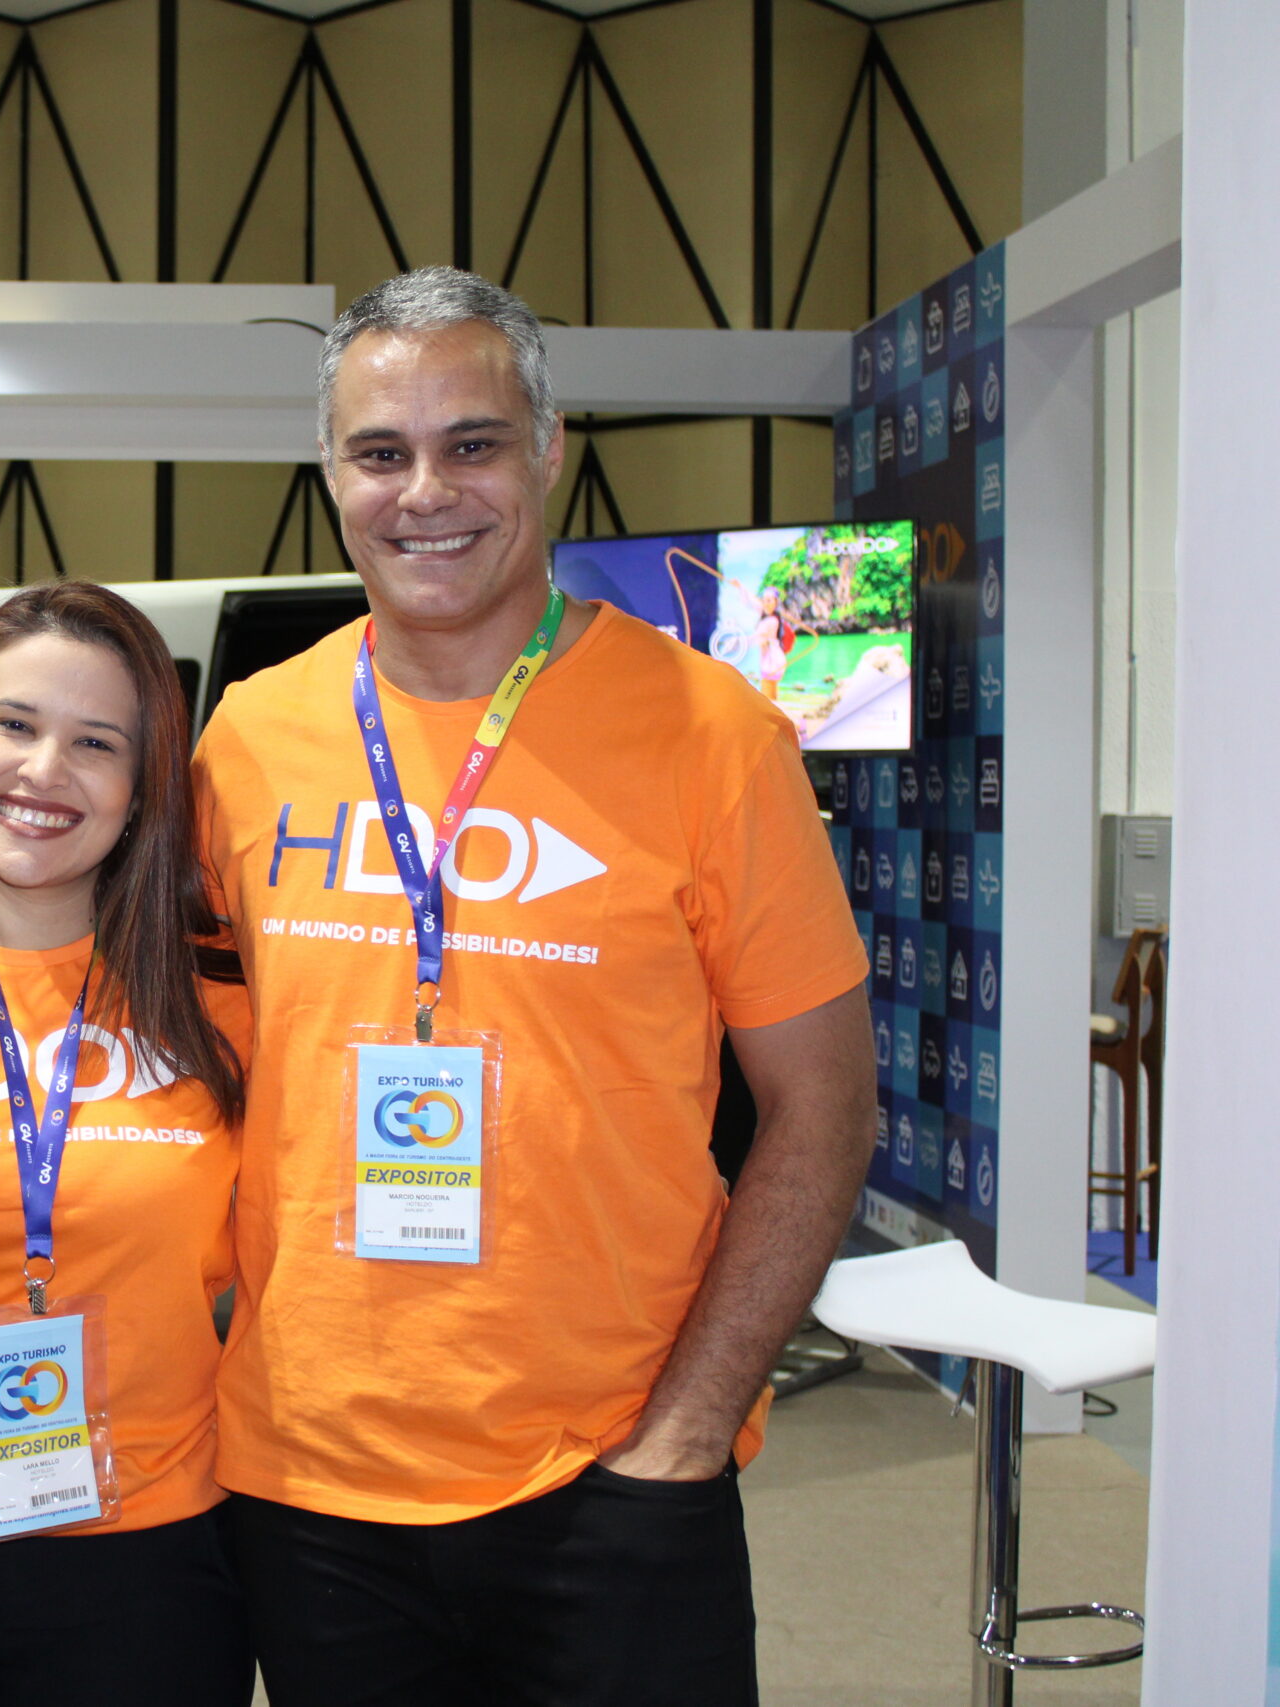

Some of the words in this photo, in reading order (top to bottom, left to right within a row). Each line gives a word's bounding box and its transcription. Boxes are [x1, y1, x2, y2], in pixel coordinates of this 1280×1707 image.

[267, 801, 531, 902] HDO
[262, 917, 286, 935] UM
[289, 919, 366, 943] MUNDO
[371, 927, 401, 946] DE
[405, 928, 599, 965] PSSIBILIDADES!
[378, 1075, 410, 1087] EXPO
[412, 1076, 464, 1088] TURISMO
[365, 1168, 472, 1187] EXPOSITOR
[415, 1194, 451, 1202] NOGUEIRA
[22, 1344, 67, 1361] TURISMO
[22, 1463, 39, 1471] LARA
[39, 1458, 61, 1467] MELLO
